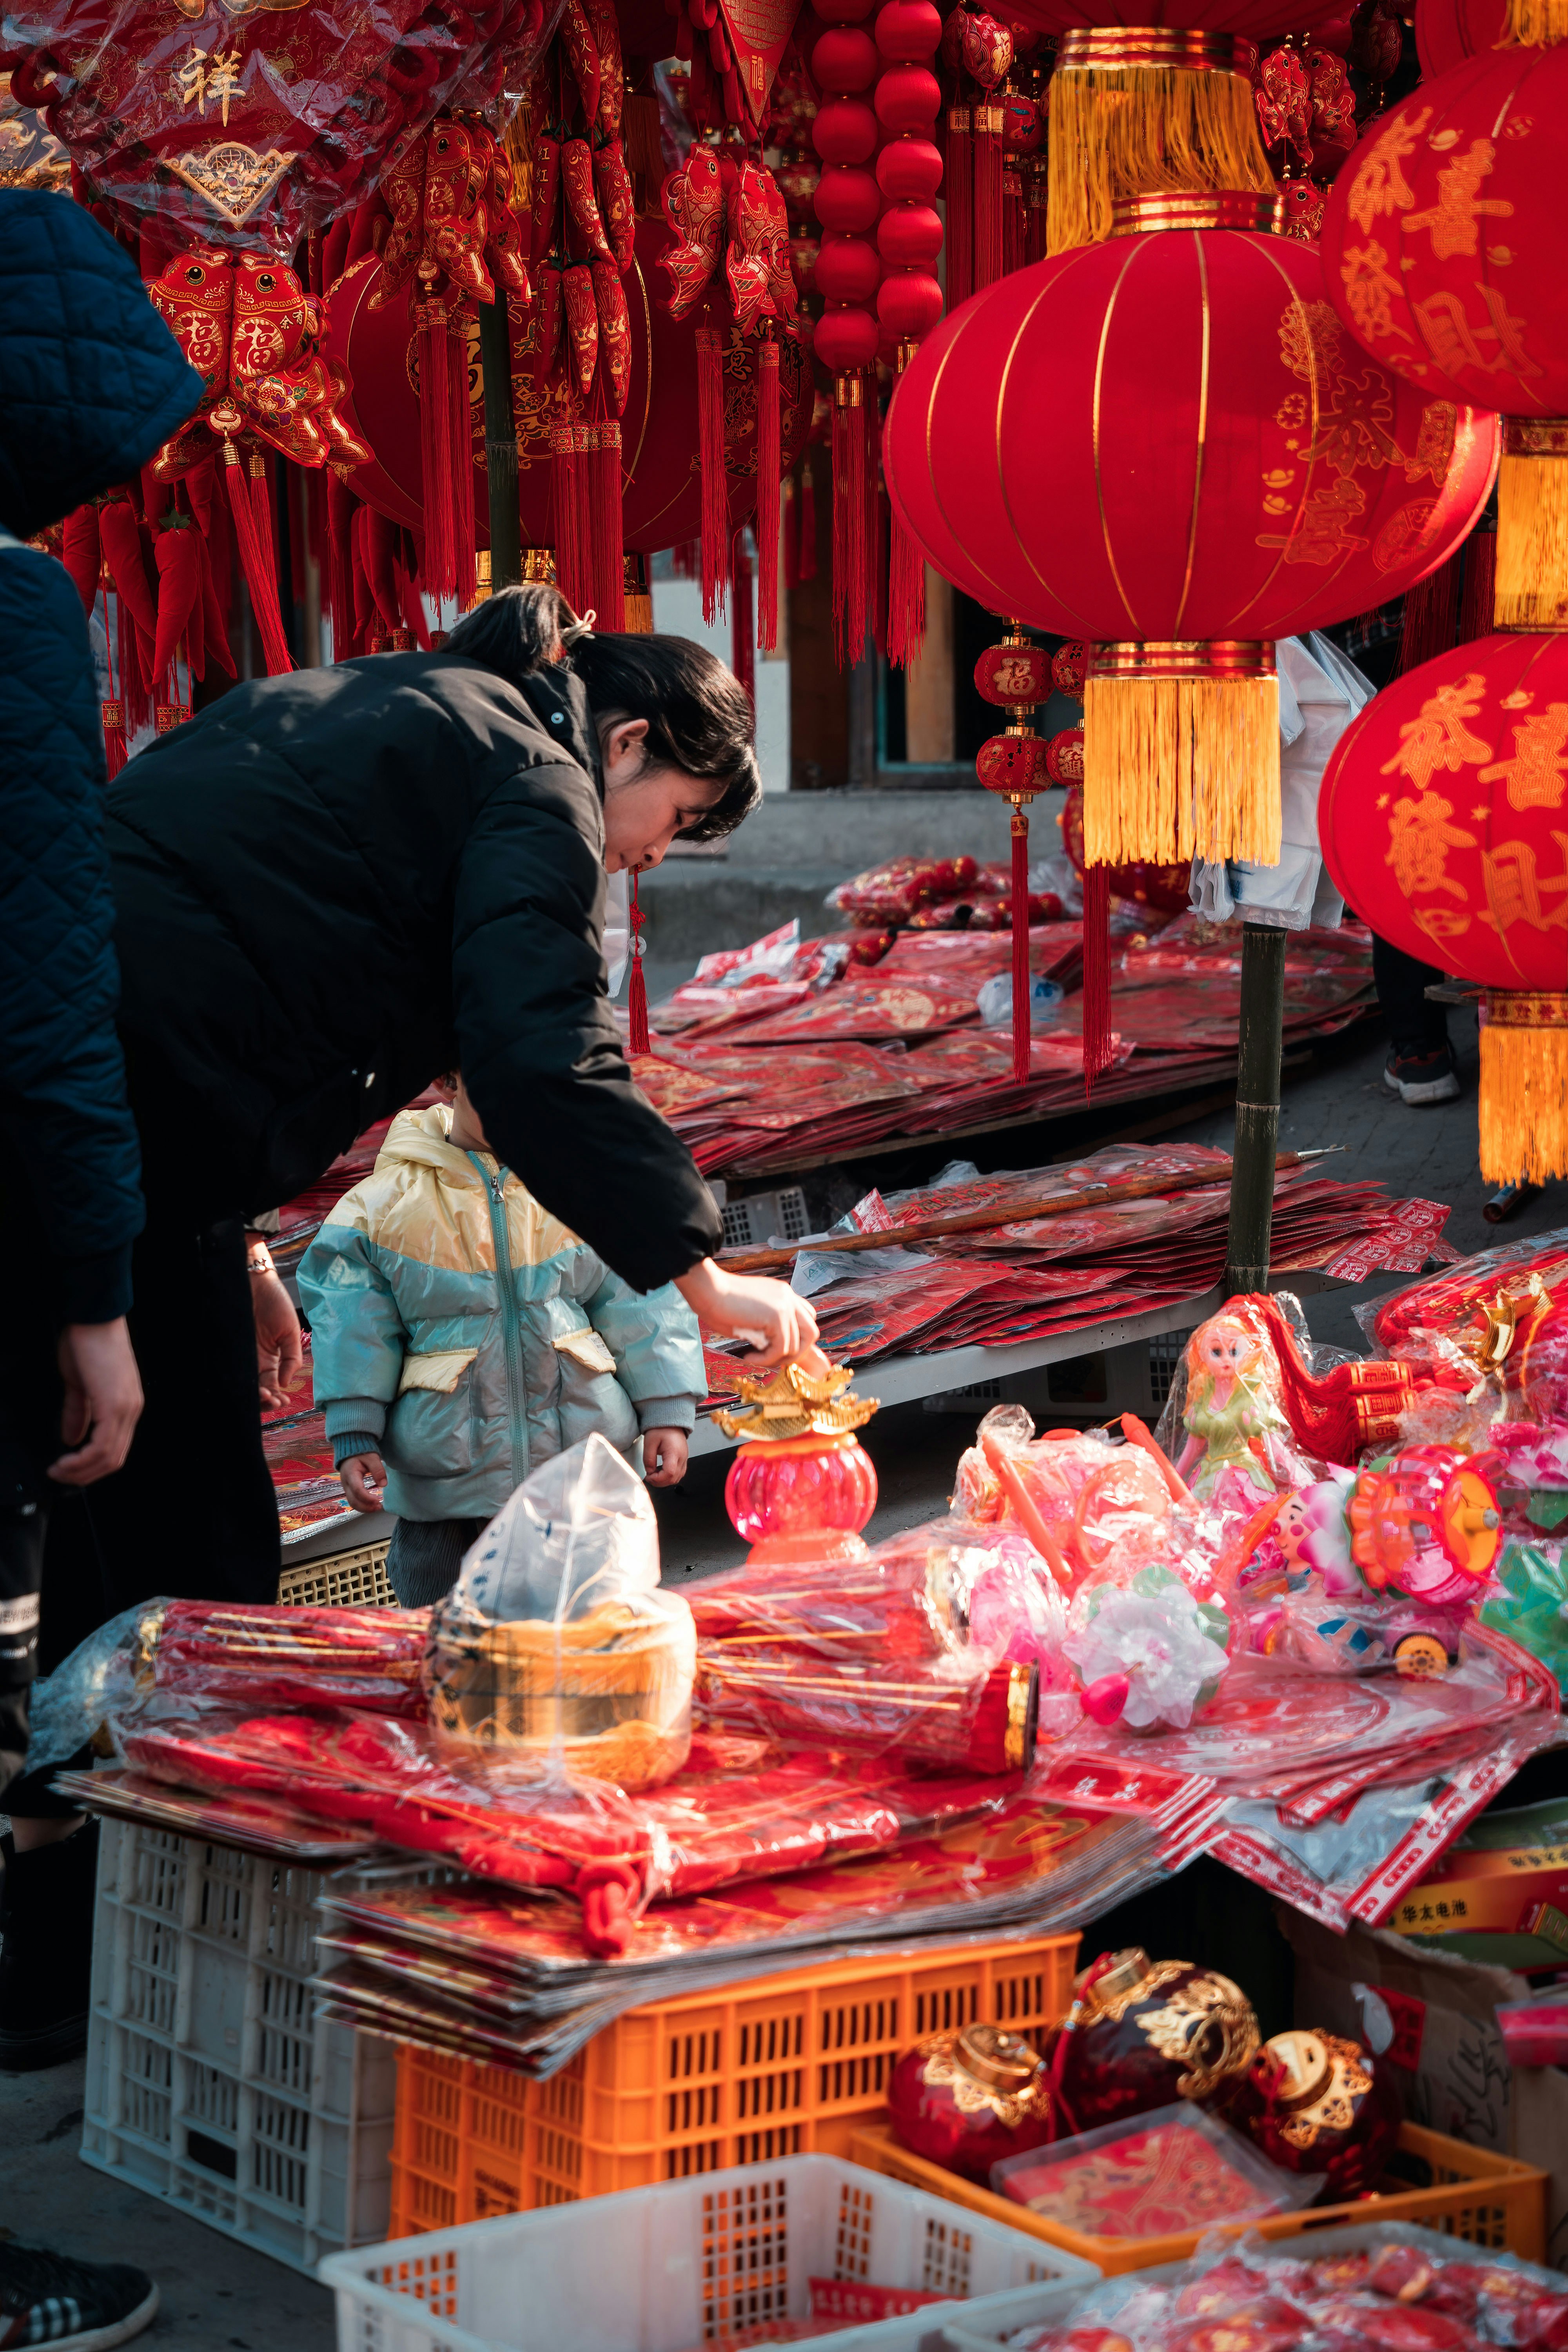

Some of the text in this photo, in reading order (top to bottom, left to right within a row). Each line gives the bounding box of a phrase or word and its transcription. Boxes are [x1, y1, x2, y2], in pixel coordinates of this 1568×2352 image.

[180, 48, 246, 127] 祥
[722, 325, 754, 381] 意
[992, 657, 1036, 697] 福
[107, 710, 118, 720] 福
[1402, 1899, 1468, 1922] 华太电池
